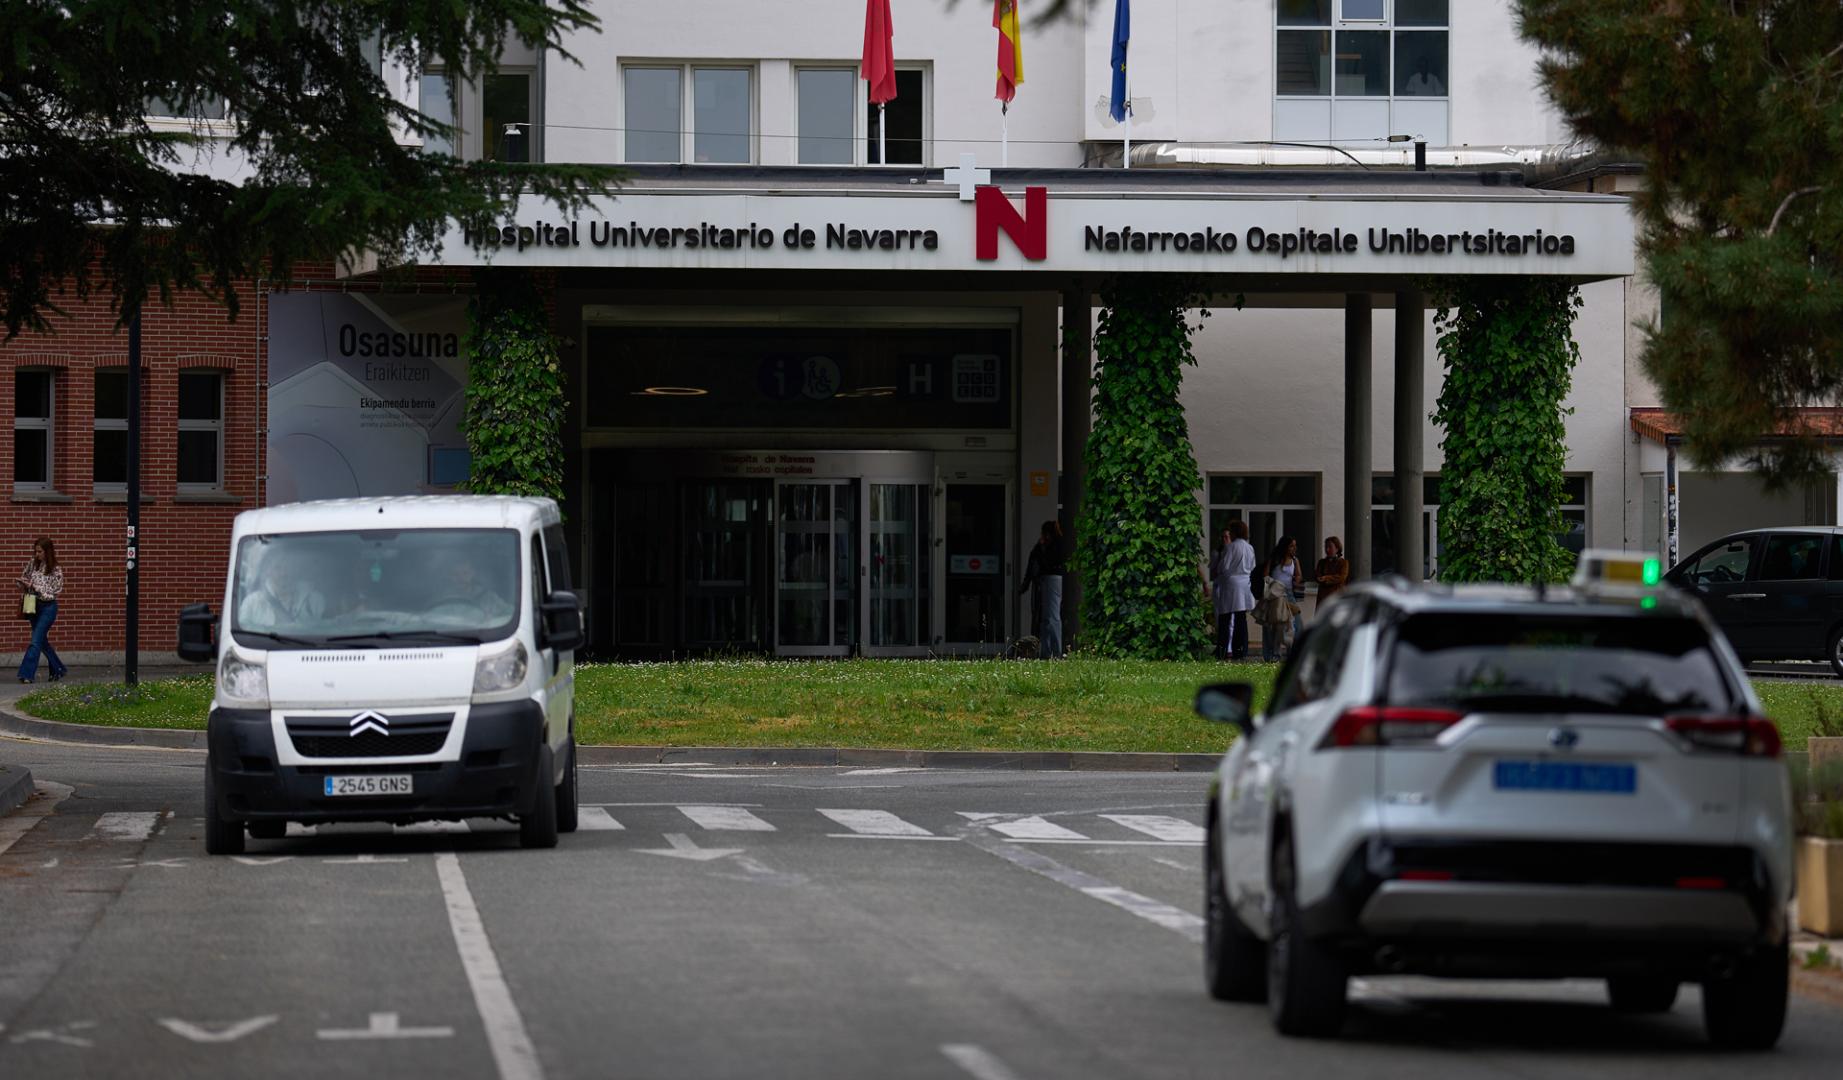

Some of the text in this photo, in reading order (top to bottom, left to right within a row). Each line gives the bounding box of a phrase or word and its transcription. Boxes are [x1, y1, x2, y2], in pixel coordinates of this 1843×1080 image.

[464, 219, 939, 252] Hospital Universitario de Navarra
[976, 186, 1047, 260] N
[1084, 225, 1575, 260] Nafarroako Ospitale Unibertsitarioa
[340, 323, 458, 357] Osasuna
[365, 362, 430, 381] Eraikitzen
[360, 398, 436, 411] Ekipamendu berria
[339, 777, 409, 793] 2545 GNS
